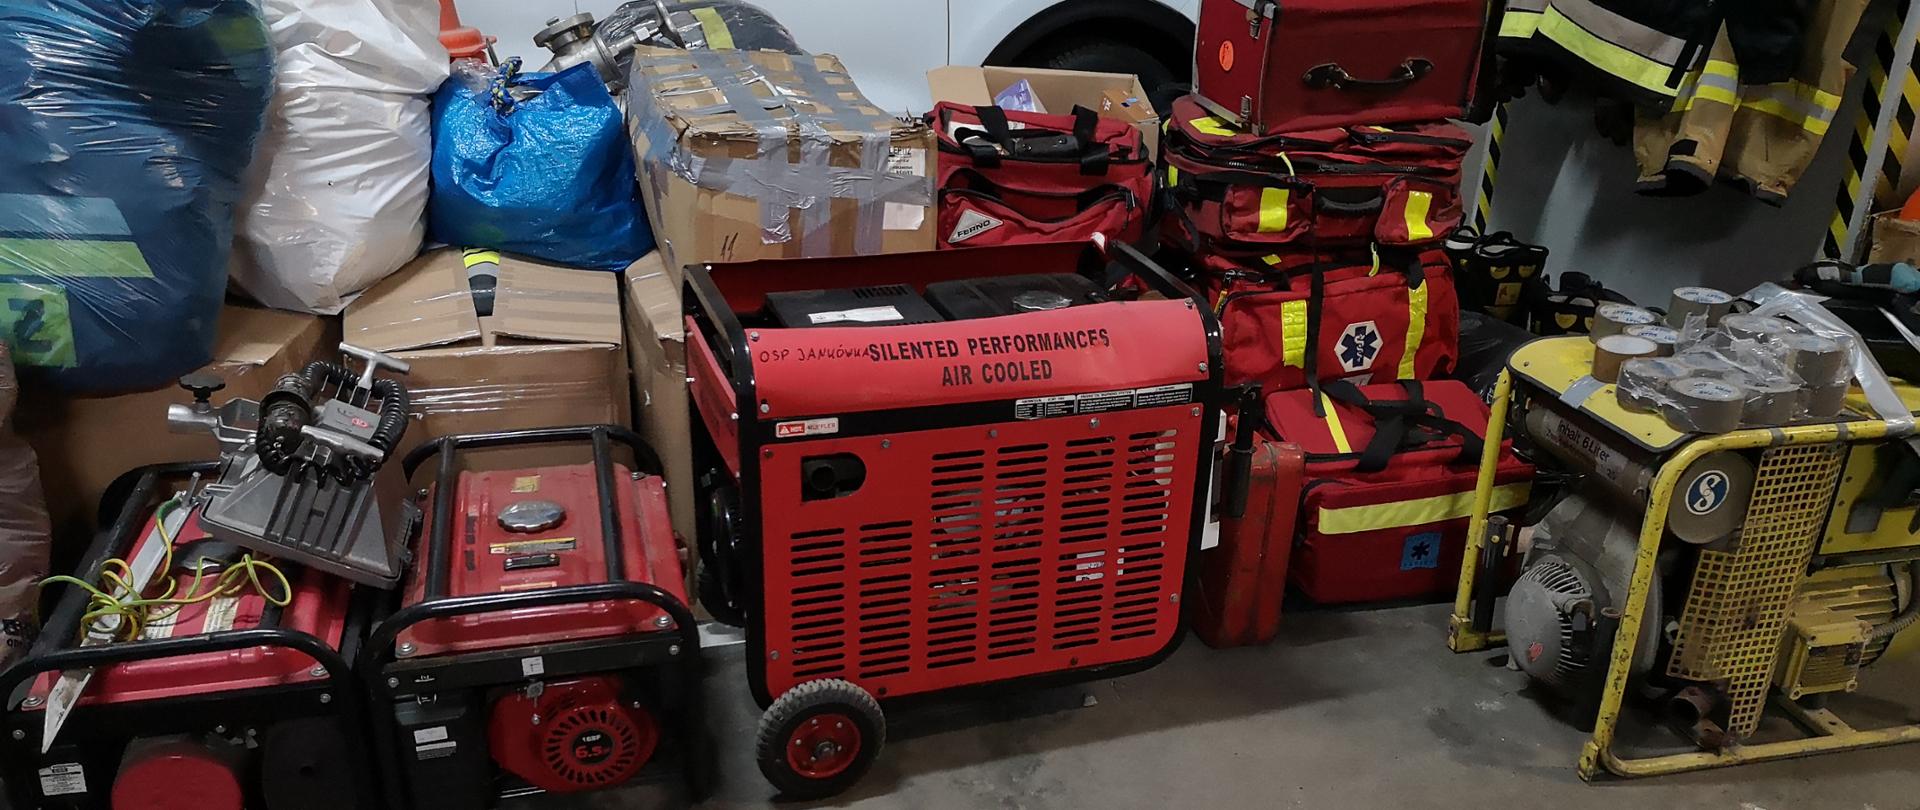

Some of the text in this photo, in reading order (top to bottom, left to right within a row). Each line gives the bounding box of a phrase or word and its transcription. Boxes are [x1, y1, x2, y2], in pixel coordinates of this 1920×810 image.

[957, 220, 990, 237] FERNO
[760, 348, 790, 363] OSP
[868, 328, 1109, 362] SILENTED PERFORMANCES
[941, 359, 1053, 386] AIR COOLED
[1558, 420, 1580, 444] Inhalt
